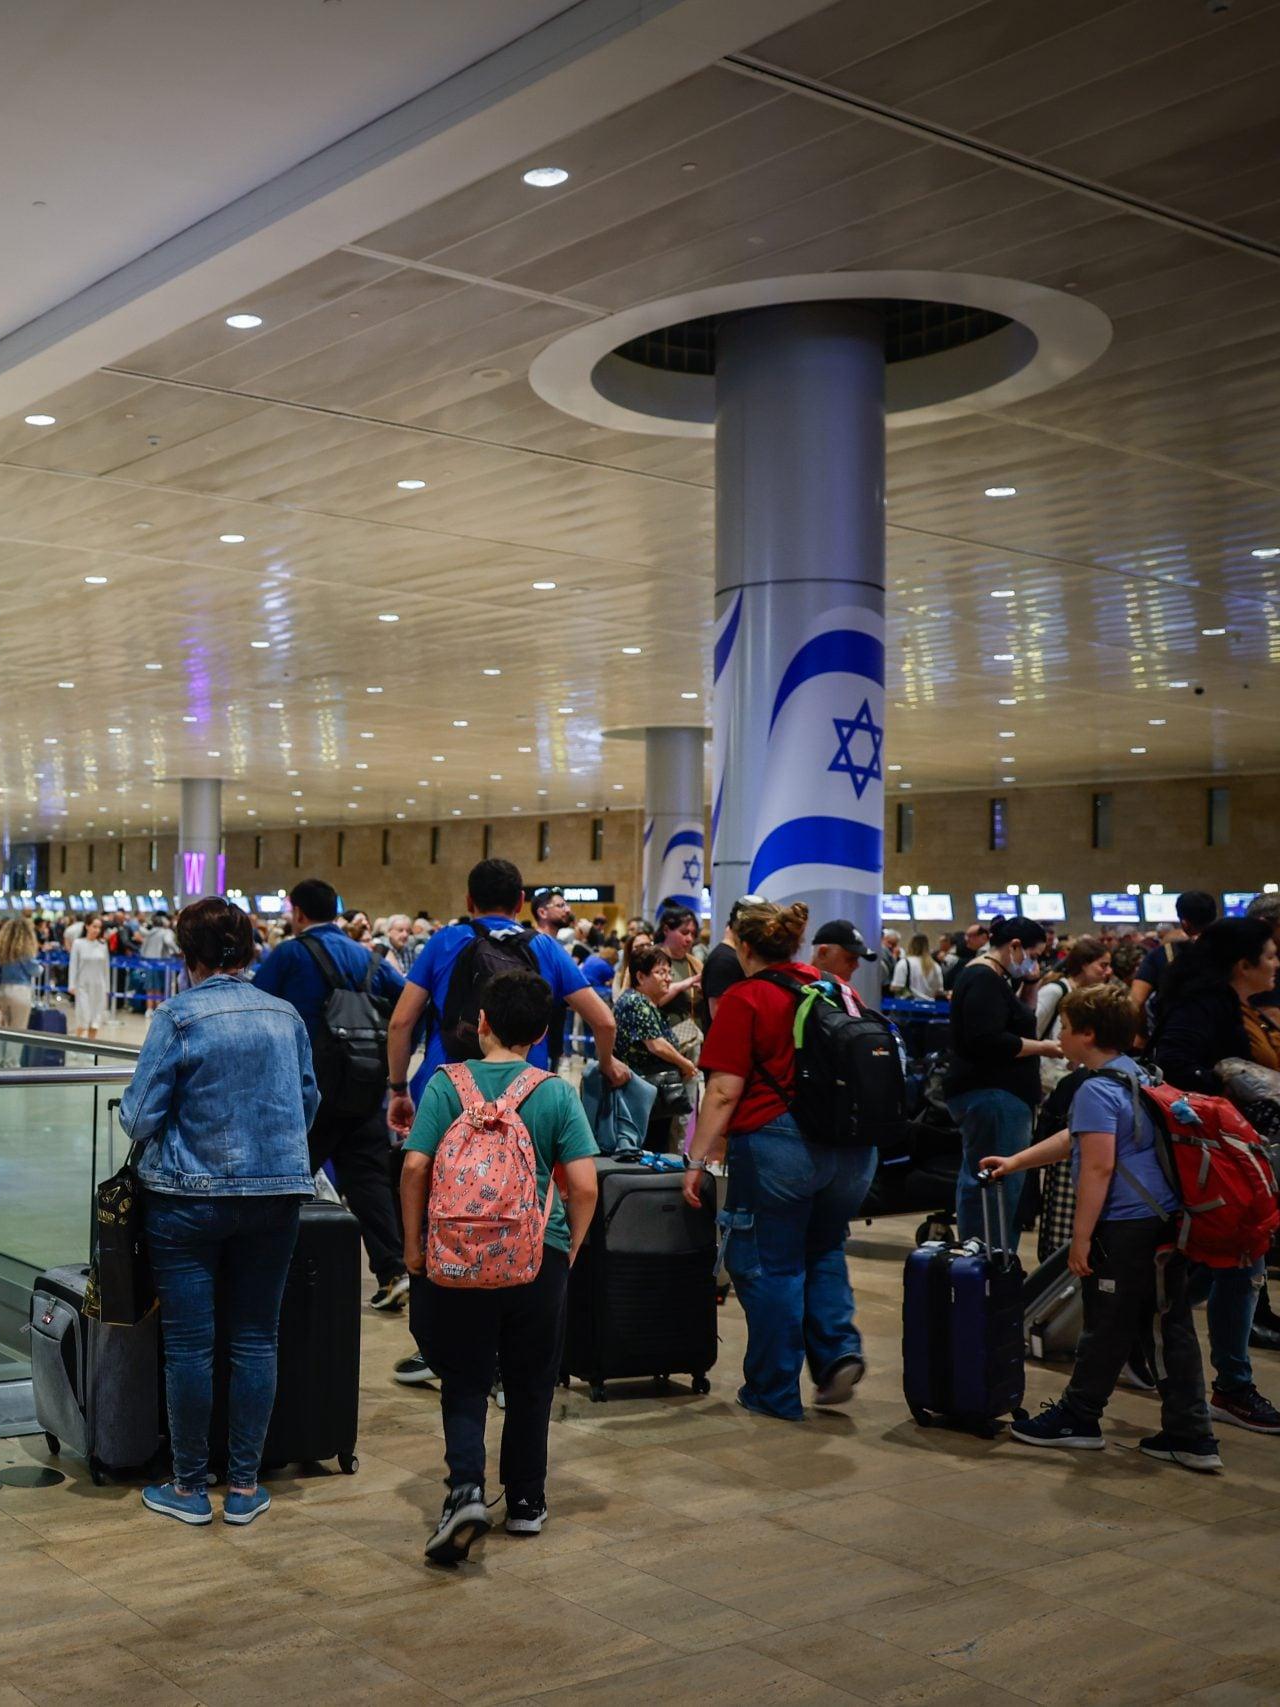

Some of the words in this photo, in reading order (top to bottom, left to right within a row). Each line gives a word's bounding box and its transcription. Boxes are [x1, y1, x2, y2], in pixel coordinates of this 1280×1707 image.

[184, 852, 205, 895] W
[440, 1262, 468, 1271] LOONEY
[443, 1268, 465, 1276] TUNES
